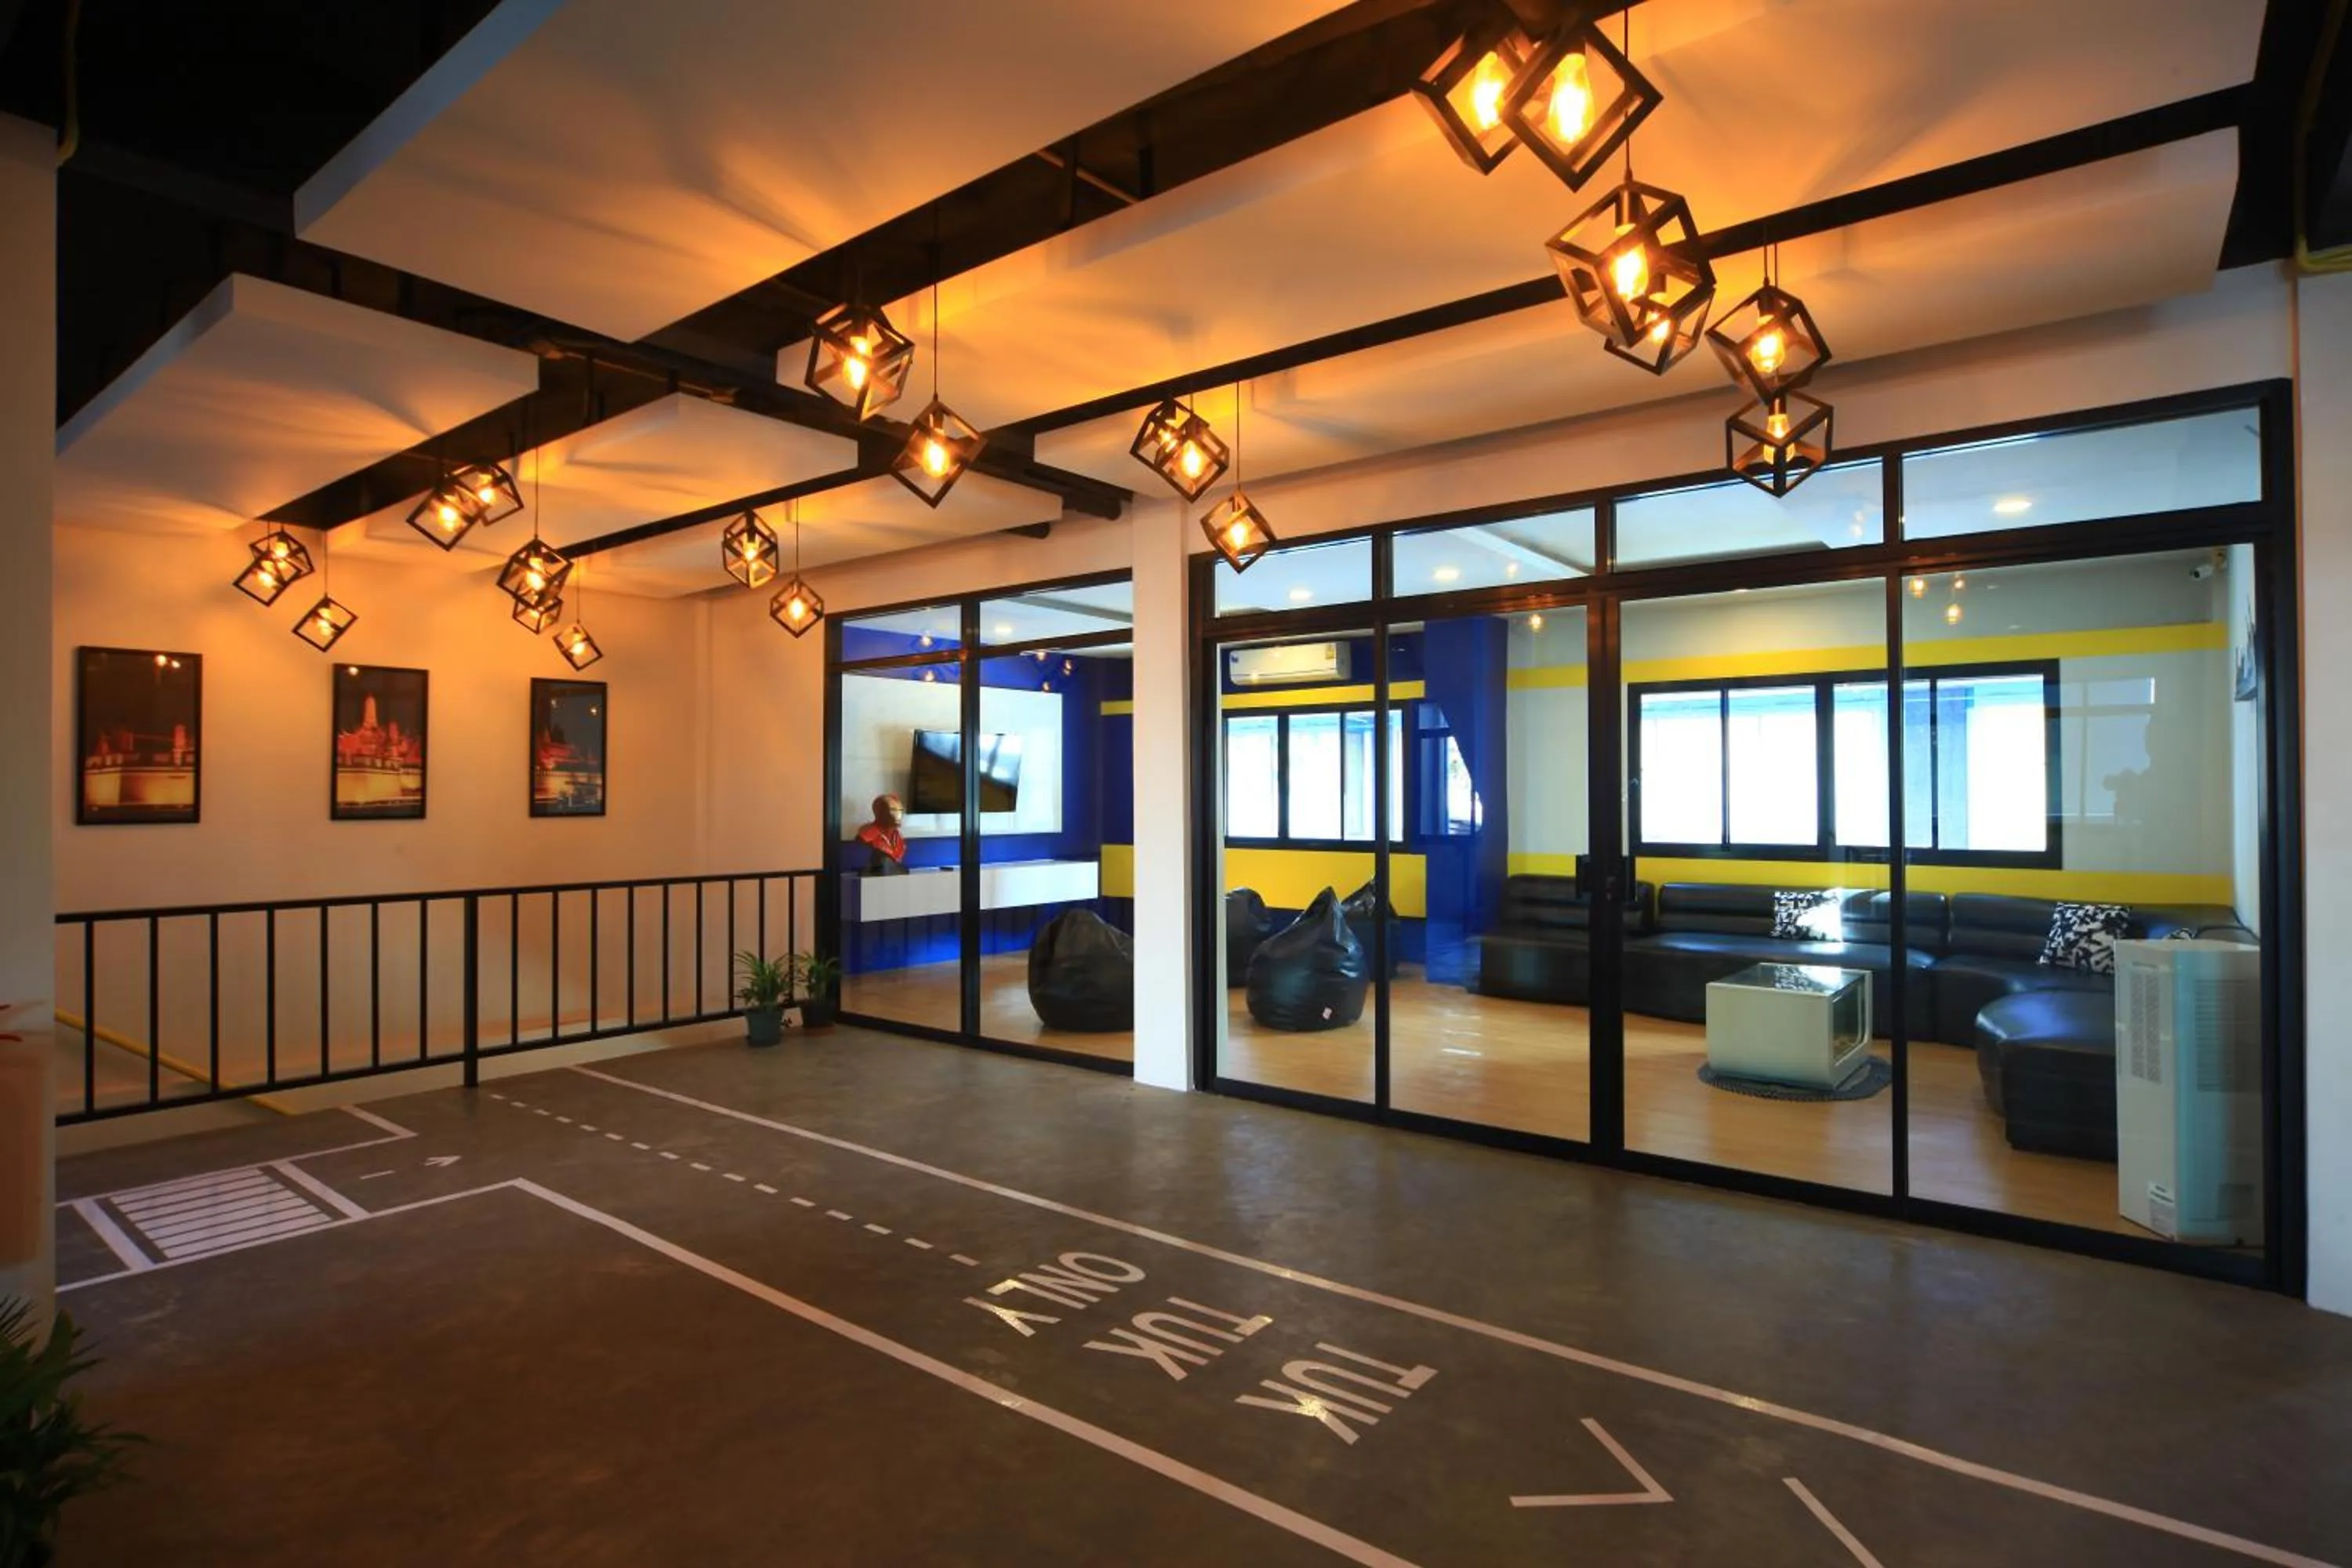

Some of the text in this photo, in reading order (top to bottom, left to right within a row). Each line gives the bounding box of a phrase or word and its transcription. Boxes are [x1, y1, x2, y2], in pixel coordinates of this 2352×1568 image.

[963, 1252, 1145, 1336] ONLY
[1082, 1297, 1273, 1381] TUK
[1235, 1342, 1439, 1445] TUK
